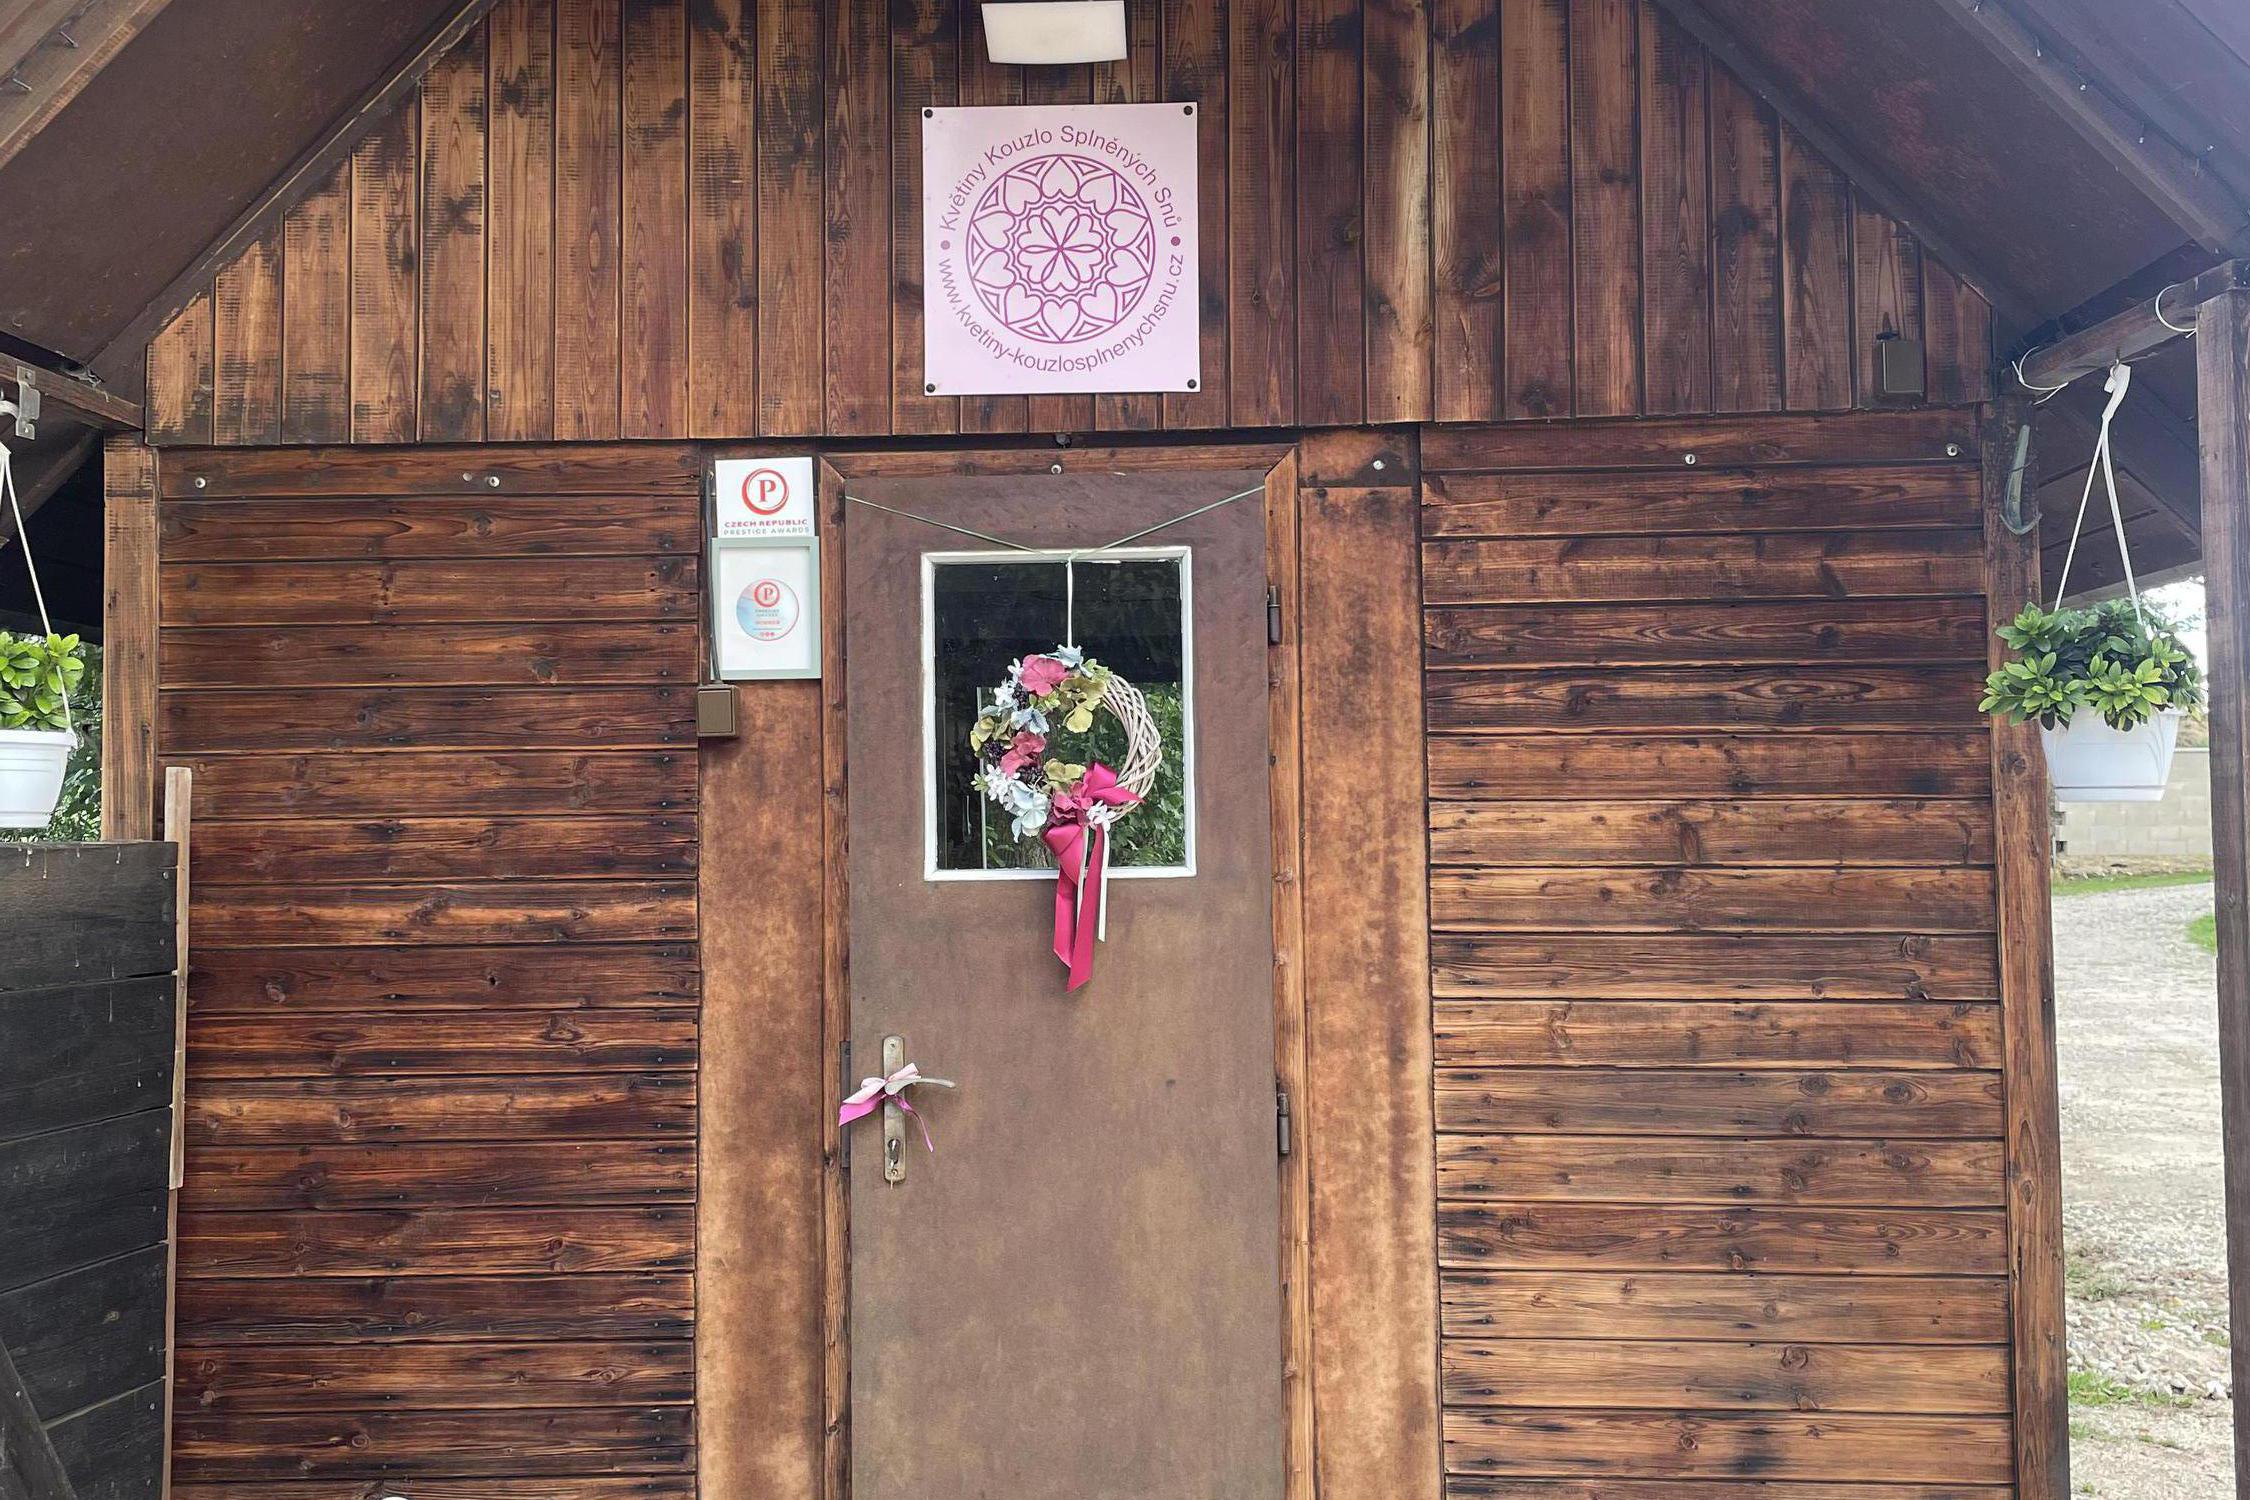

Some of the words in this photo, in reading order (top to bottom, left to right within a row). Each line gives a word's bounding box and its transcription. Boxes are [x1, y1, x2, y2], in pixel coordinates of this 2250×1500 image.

[939, 163, 987, 231] Květiny
[984, 128, 1053, 166] Kouzlo
[1060, 125, 1157, 186] Splněných
[1154, 187, 1182, 228] Snů
[938, 254, 1184, 373] www.kvetiny-kouzlosplnenychsnu.cz
[758, 479, 777, 502] P
[724, 520, 757, 528] CZECH
[759, 518, 808, 527] REPUBLIC
[770, 526, 810, 534] AWARDS
